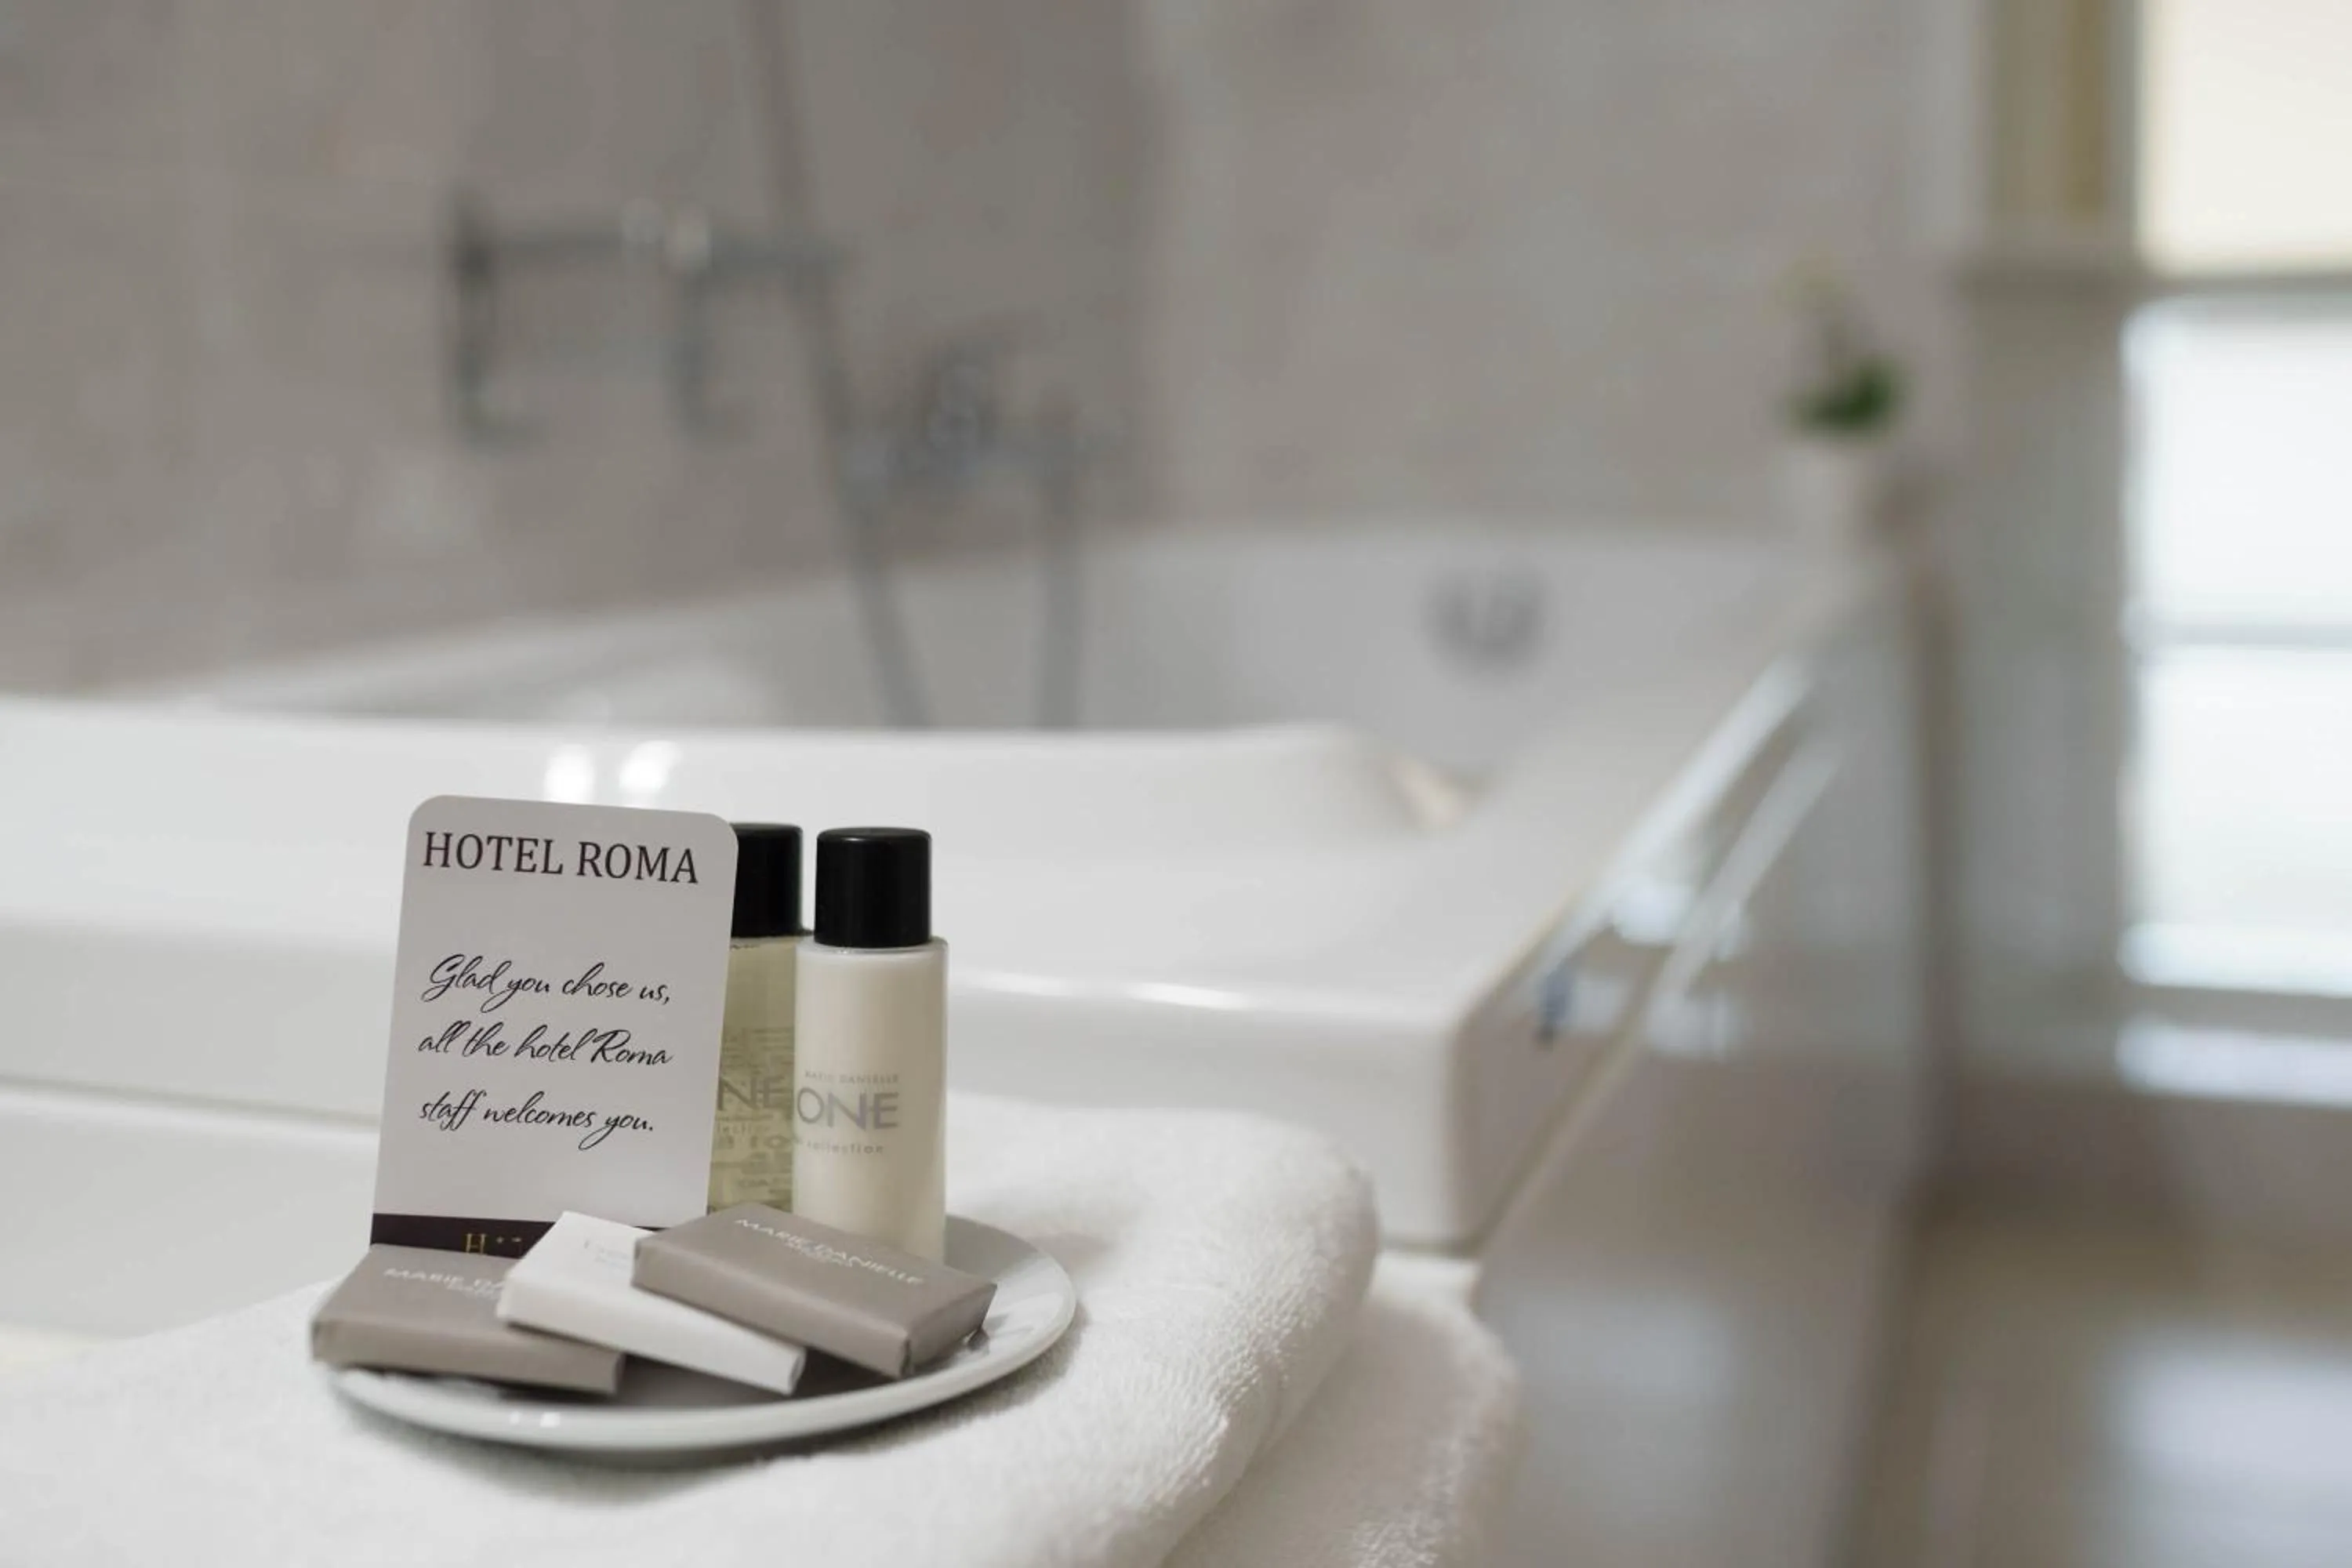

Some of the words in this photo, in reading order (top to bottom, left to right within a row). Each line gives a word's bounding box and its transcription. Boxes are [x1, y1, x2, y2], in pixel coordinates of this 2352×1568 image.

[423, 831, 564, 875] HOTEL
[576, 840, 699, 884] ROMA
[420, 953, 513, 1003] Glad
[480, 978, 550, 1014] you
[561, 962, 633, 999] chose
[638, 984, 672, 1005] us,
[418, 1020, 472, 1055] all
[461, 1022, 511, 1058] the
[513, 1024, 598, 1063] hotel
[590, 1029, 674, 1066] Roma
[717, 1075, 786, 1112] NE
[797, 1087, 900, 1131] ONE
[418, 1088, 488, 1131] staff
[482, 1091, 597, 1127] welcomes
[577, 1113, 655, 1151] you.
